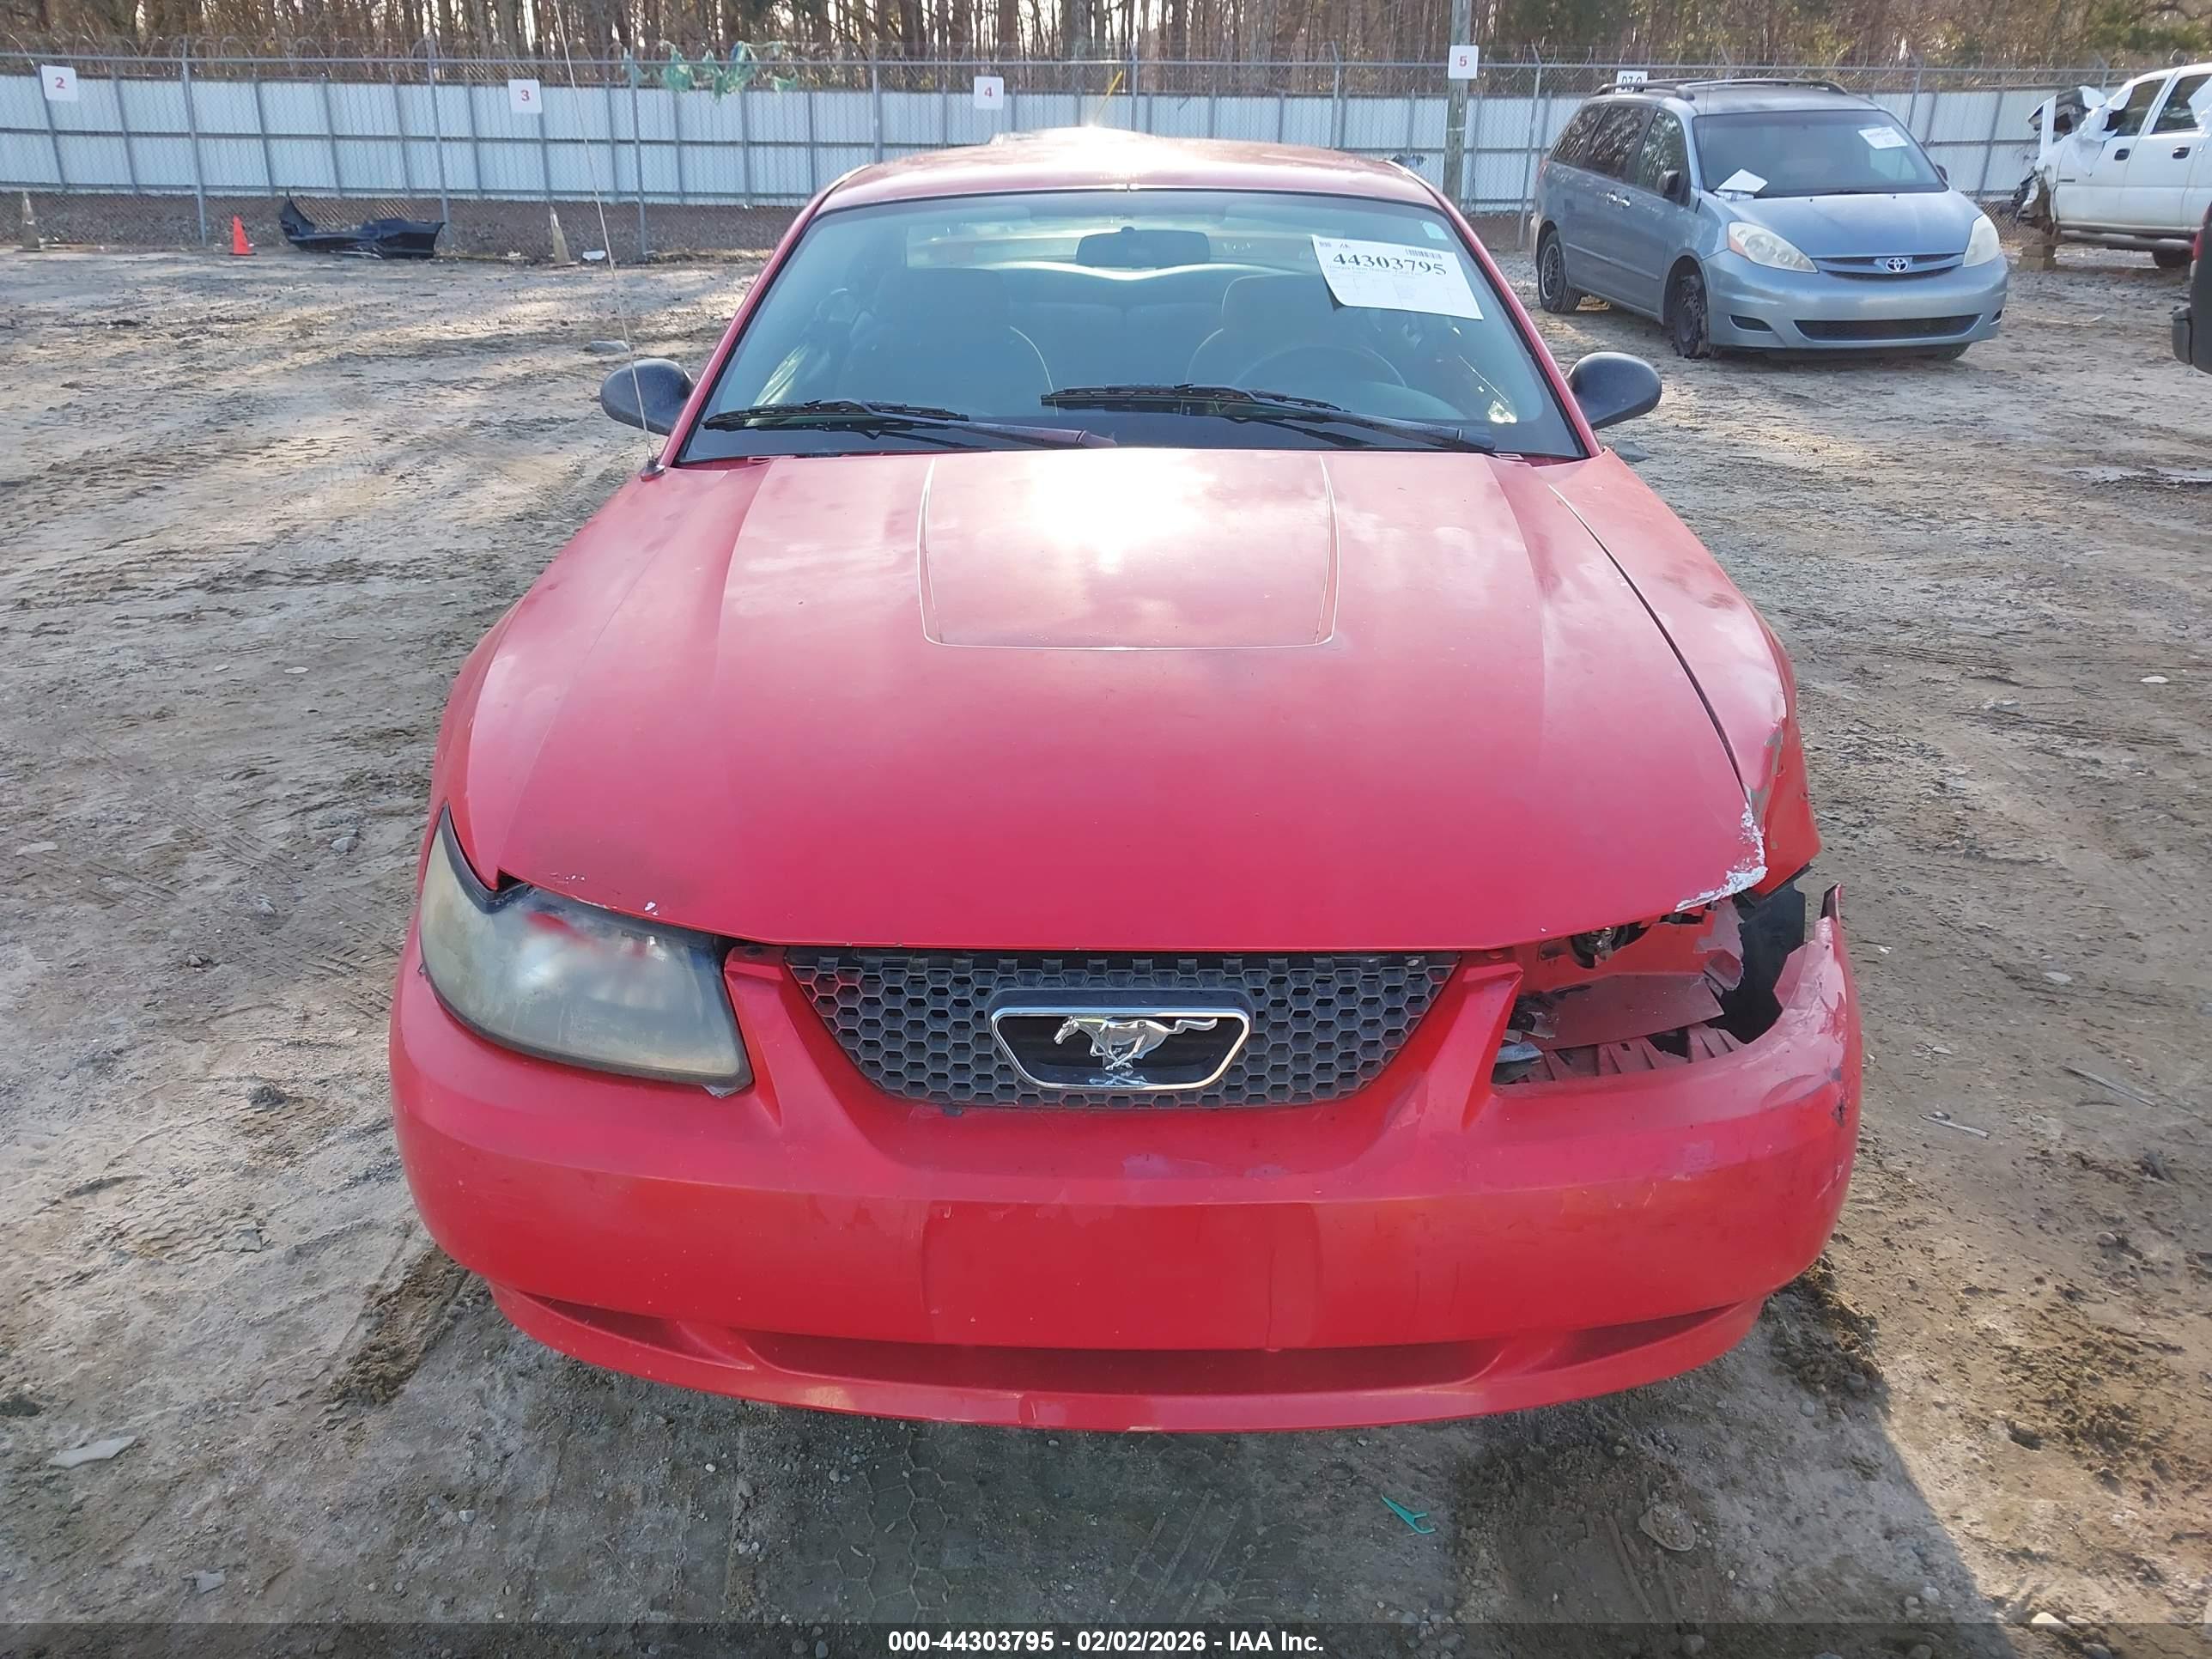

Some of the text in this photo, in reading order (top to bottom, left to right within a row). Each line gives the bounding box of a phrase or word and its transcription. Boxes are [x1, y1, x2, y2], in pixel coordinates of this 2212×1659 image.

[1459, 55, 1468, 67] 5
[55, 76, 65, 89] 2
[520, 89, 530, 101] 3
[984, 87, 994, 98] 4
[1333, 252, 1447, 276] 44303795
